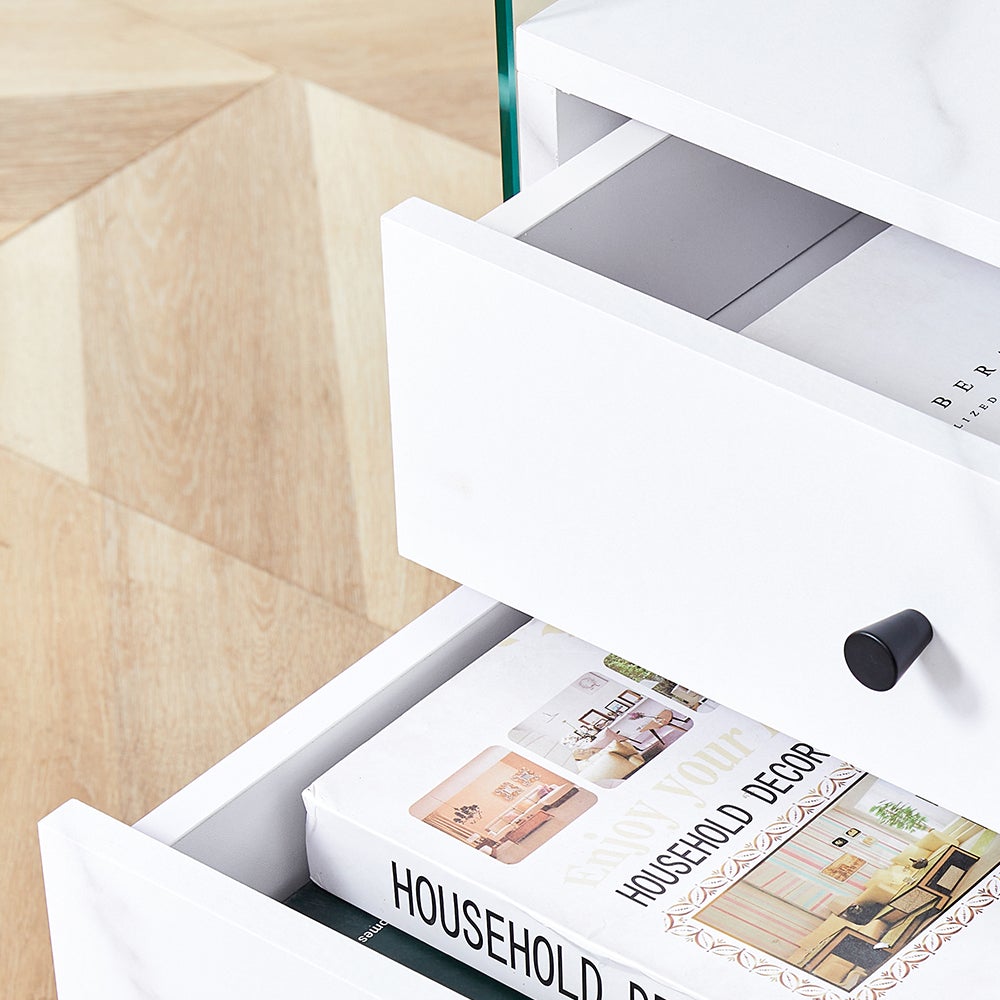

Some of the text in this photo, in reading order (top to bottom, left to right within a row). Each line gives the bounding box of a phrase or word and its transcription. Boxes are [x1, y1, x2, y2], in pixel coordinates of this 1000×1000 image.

[953, 396, 998, 429] LIZED
[562, 726, 754, 889] Enjoy your
[615, 742, 831, 907] HOUSEHOLD DECOR
